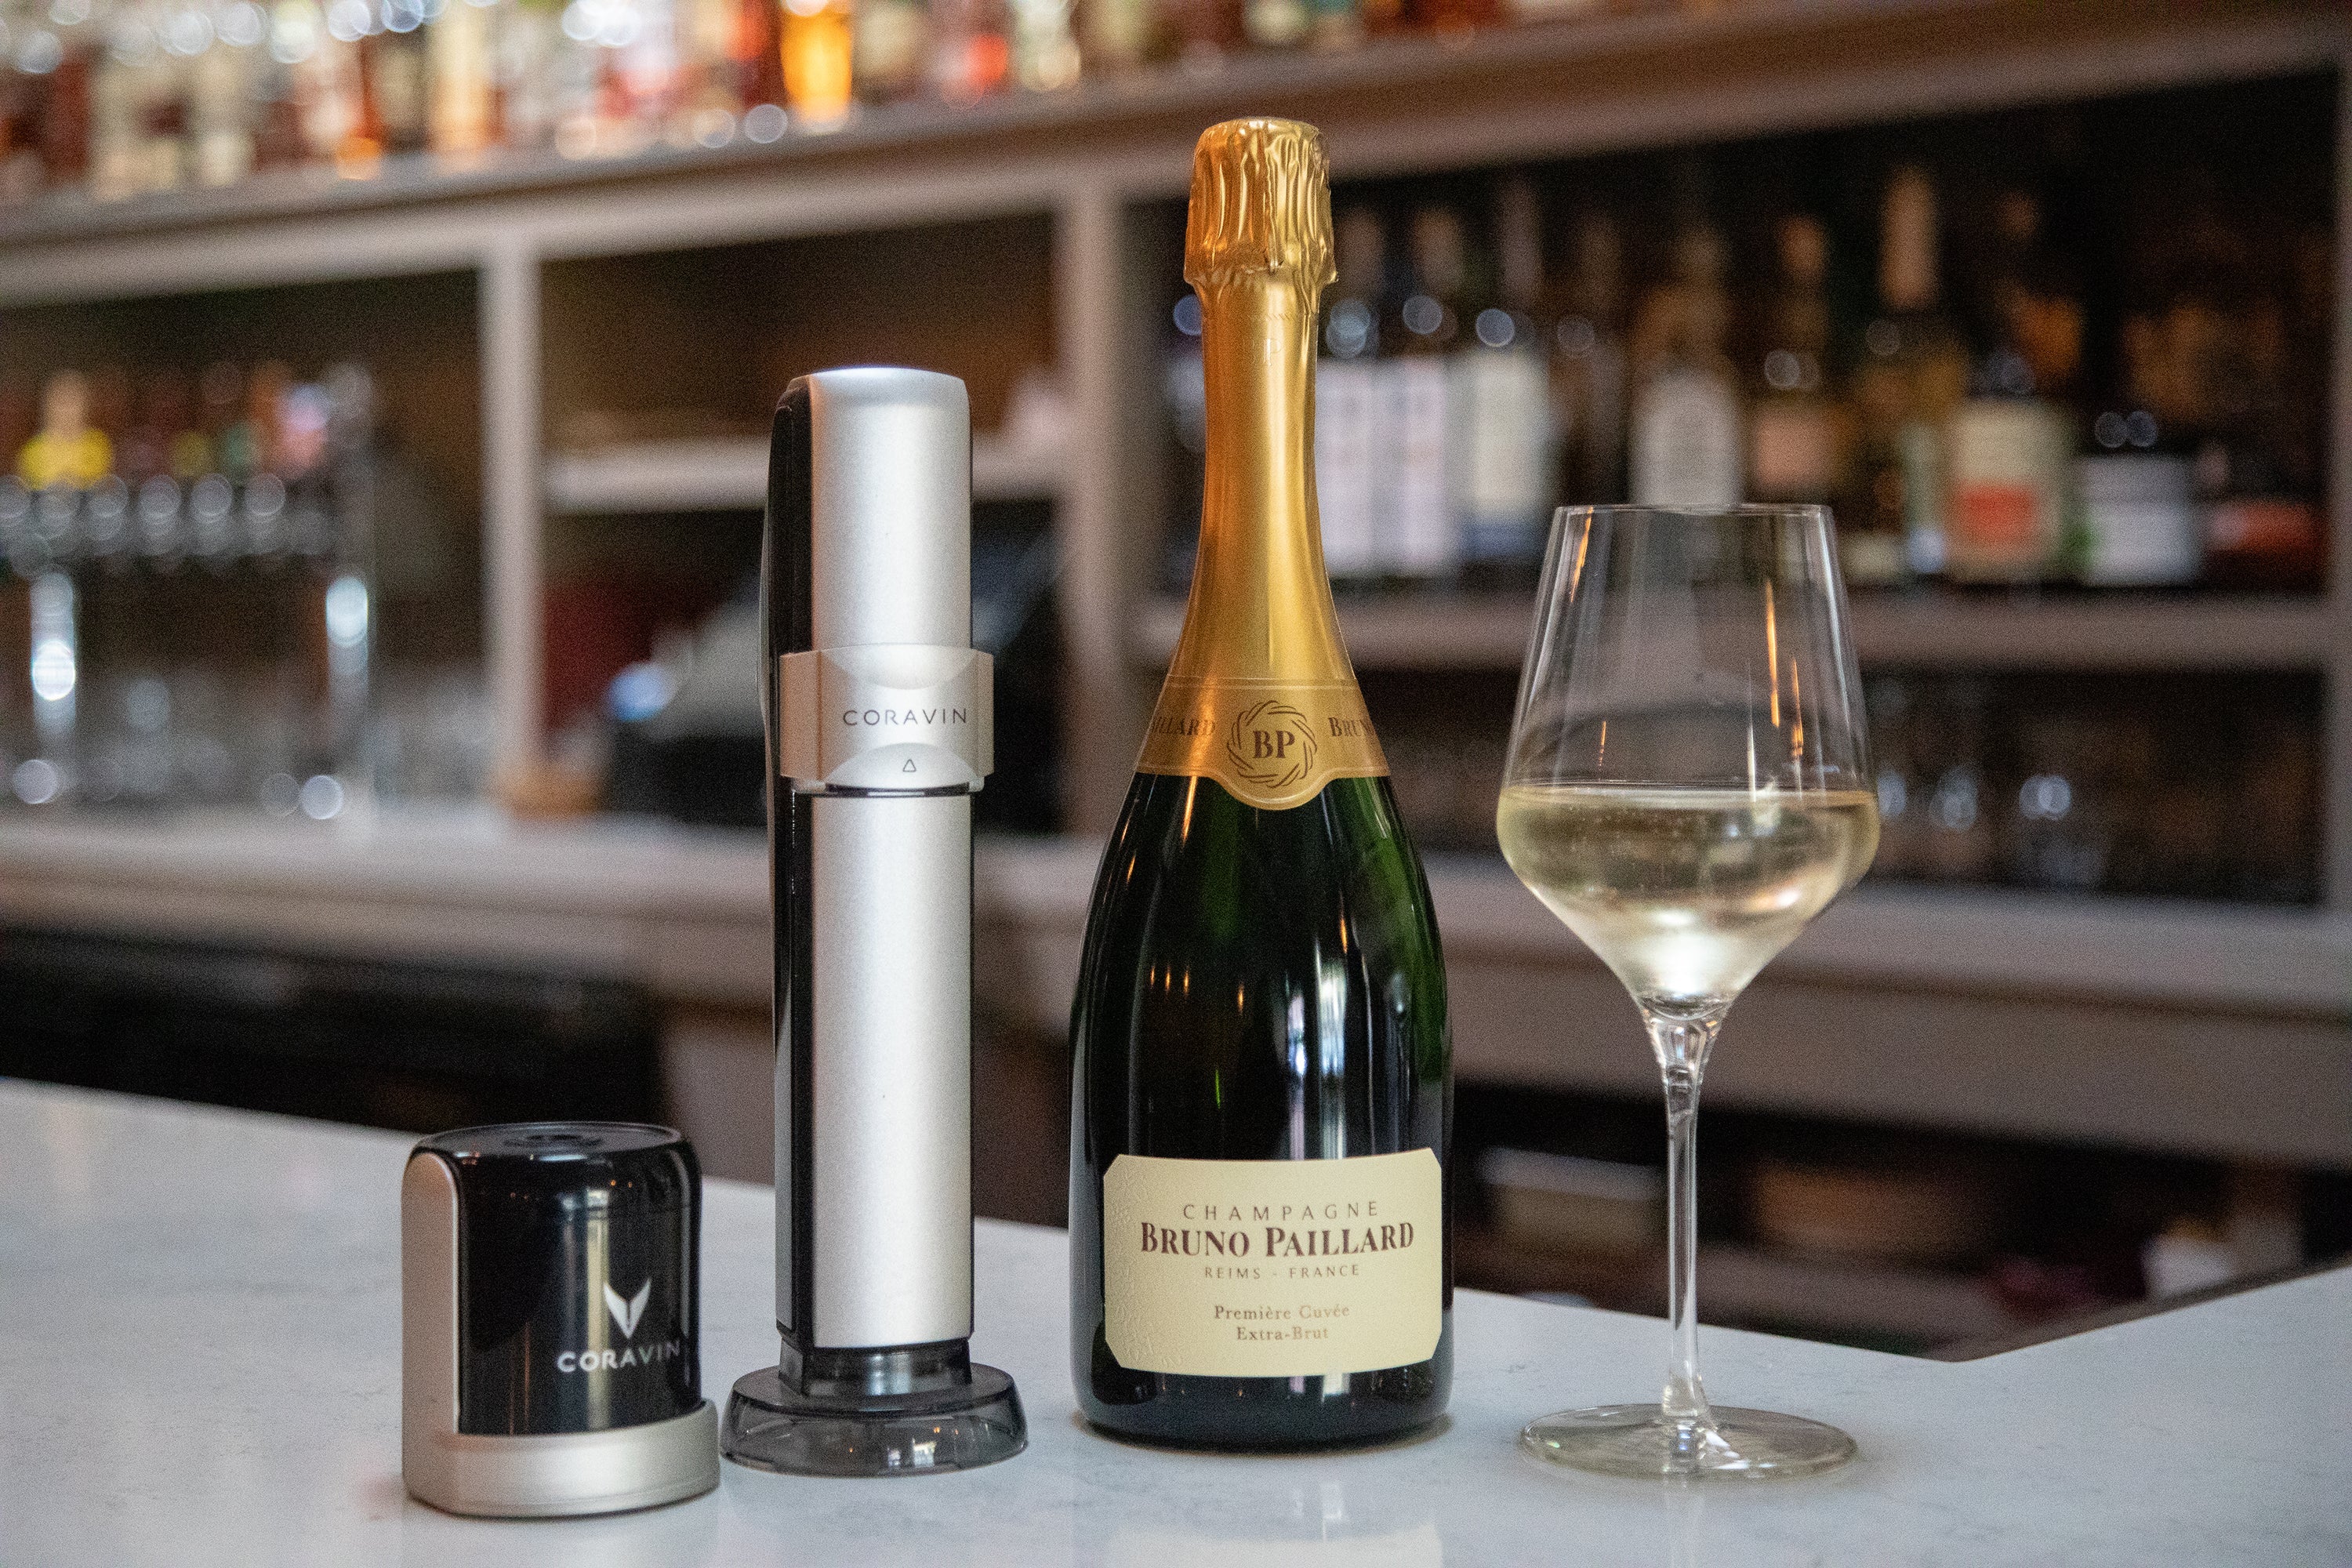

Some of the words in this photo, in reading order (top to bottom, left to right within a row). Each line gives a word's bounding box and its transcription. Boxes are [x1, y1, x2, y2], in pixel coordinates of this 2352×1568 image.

[843, 709, 967, 726] CORAVIN
[1152, 716, 1216, 735] ILLARD
[1252, 730, 1295, 759] BP
[1183, 1201, 1377, 1221] CHAMPAGNE
[1141, 1222, 1250, 1258] BRUNO
[1265, 1222, 1414, 1258] PAILLARD
[1205, 1267, 1261, 1279] REIMS
[1290, 1265, 1359, 1279] FRANCE
[1214, 1305, 1291, 1319] Première
[1299, 1304, 1350, 1319] Cuvée
[1237, 1326, 1329, 1341] Extra-Brut
[557, 1340, 681, 1372] CORAVIN
